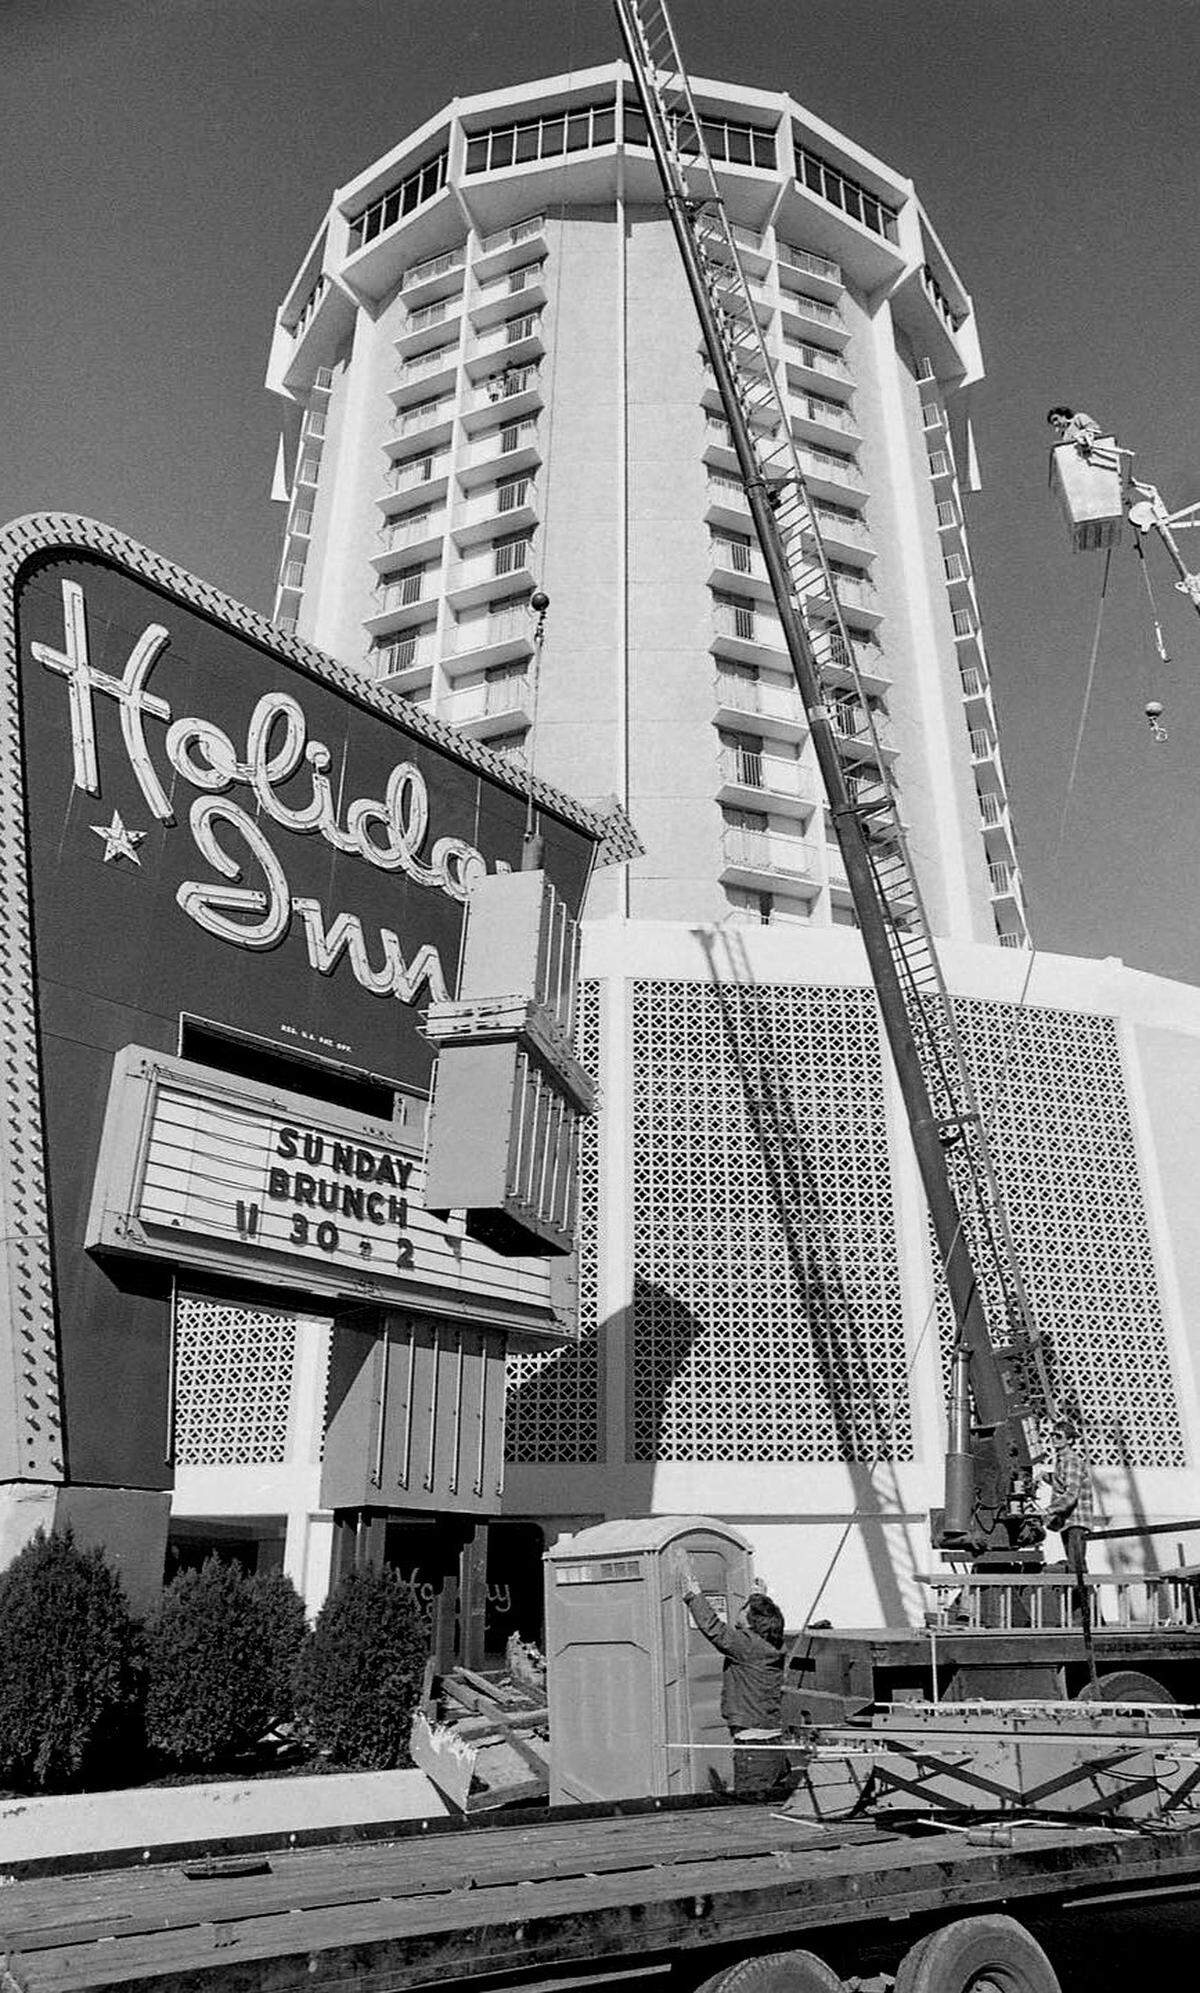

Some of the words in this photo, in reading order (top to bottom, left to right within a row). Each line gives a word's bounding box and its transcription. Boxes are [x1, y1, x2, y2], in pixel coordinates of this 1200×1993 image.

[31, 579, 511, 902] Holida
[176, 796, 459, 1005] Inn
[277, 1127, 413, 1191] SUNDAY
[268, 1166, 408, 1230] BRUNCH
[290, 1212, 340, 1254] 30
[396, 1236, 415, 1272] 2
